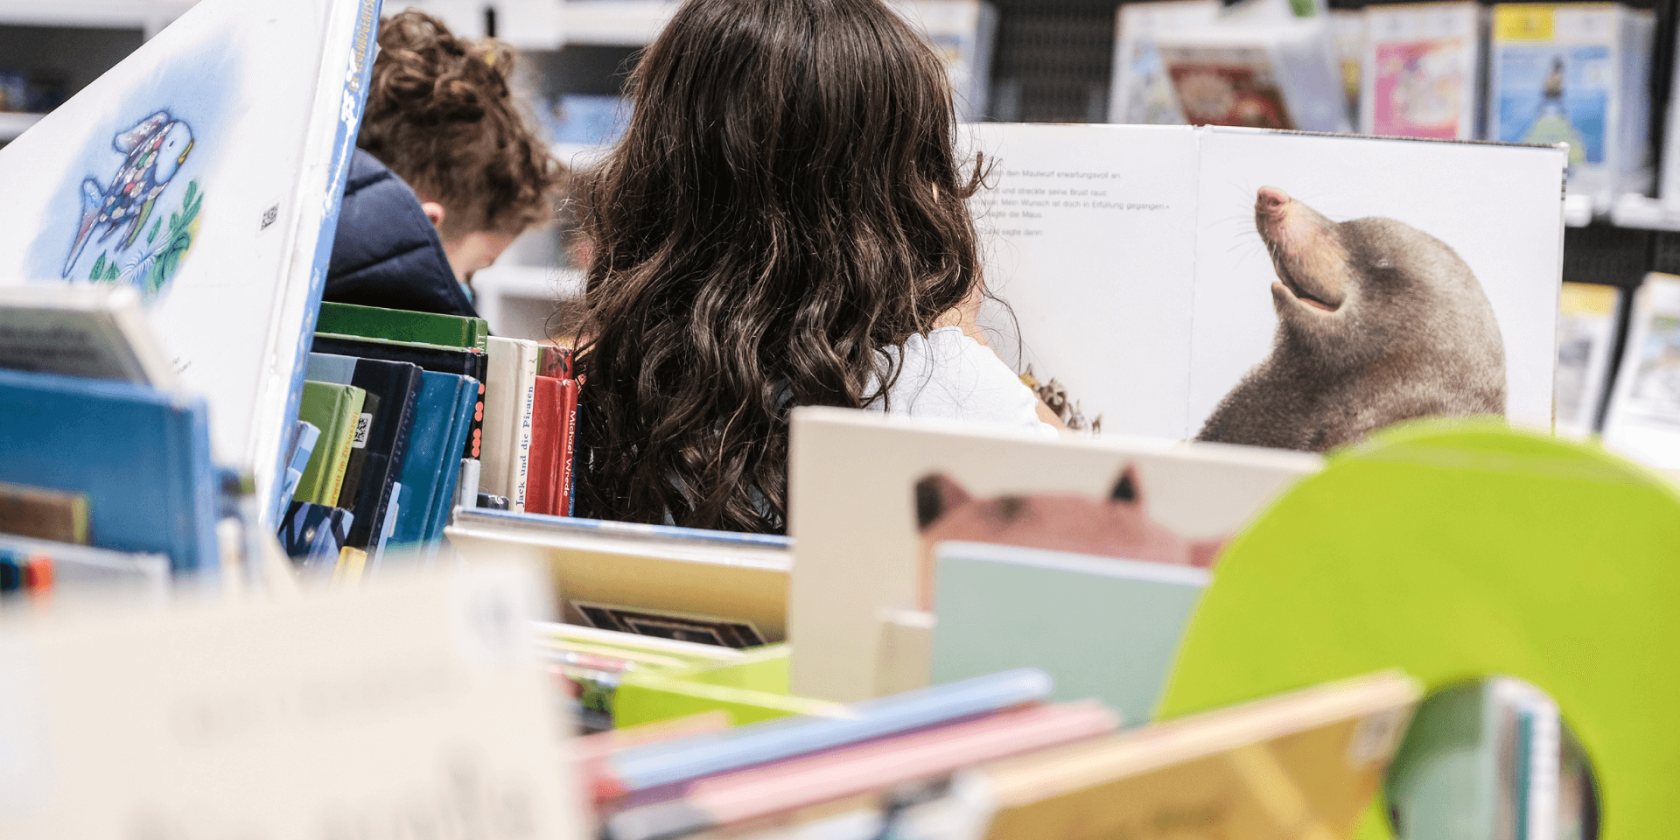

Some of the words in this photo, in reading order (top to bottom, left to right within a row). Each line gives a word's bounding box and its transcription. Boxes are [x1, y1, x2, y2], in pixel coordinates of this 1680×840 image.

[356, 0, 376, 74] EGENBOGENFIS
[1006, 169, 1020, 177] den
[1022, 169, 1055, 178] Maulwurf
[1057, 171, 1109, 180] erwartungsvoll
[1002, 187, 1016, 195] und
[1018, 187, 1046, 195] streckte
[1048, 188, 1067, 196] seine
[1070, 188, 1088, 197] Brust
[1021, 199, 1050, 207] Wunsch
[1092, 201, 1124, 210] Erfüllung
[1002, 228, 1021, 237] sagte
[523, 386, 534, 428] Piraten
[341, 412, 359, 459] Zirkuszelt
[521, 433, 529, 451] die
[567, 410, 577, 454] Michael
[338, 461, 346, 473] im
[520, 455, 528, 477] und
[563, 458, 572, 497] Wrede
[330, 473, 342, 507] erwelt
[516, 481, 526, 508] Jack
